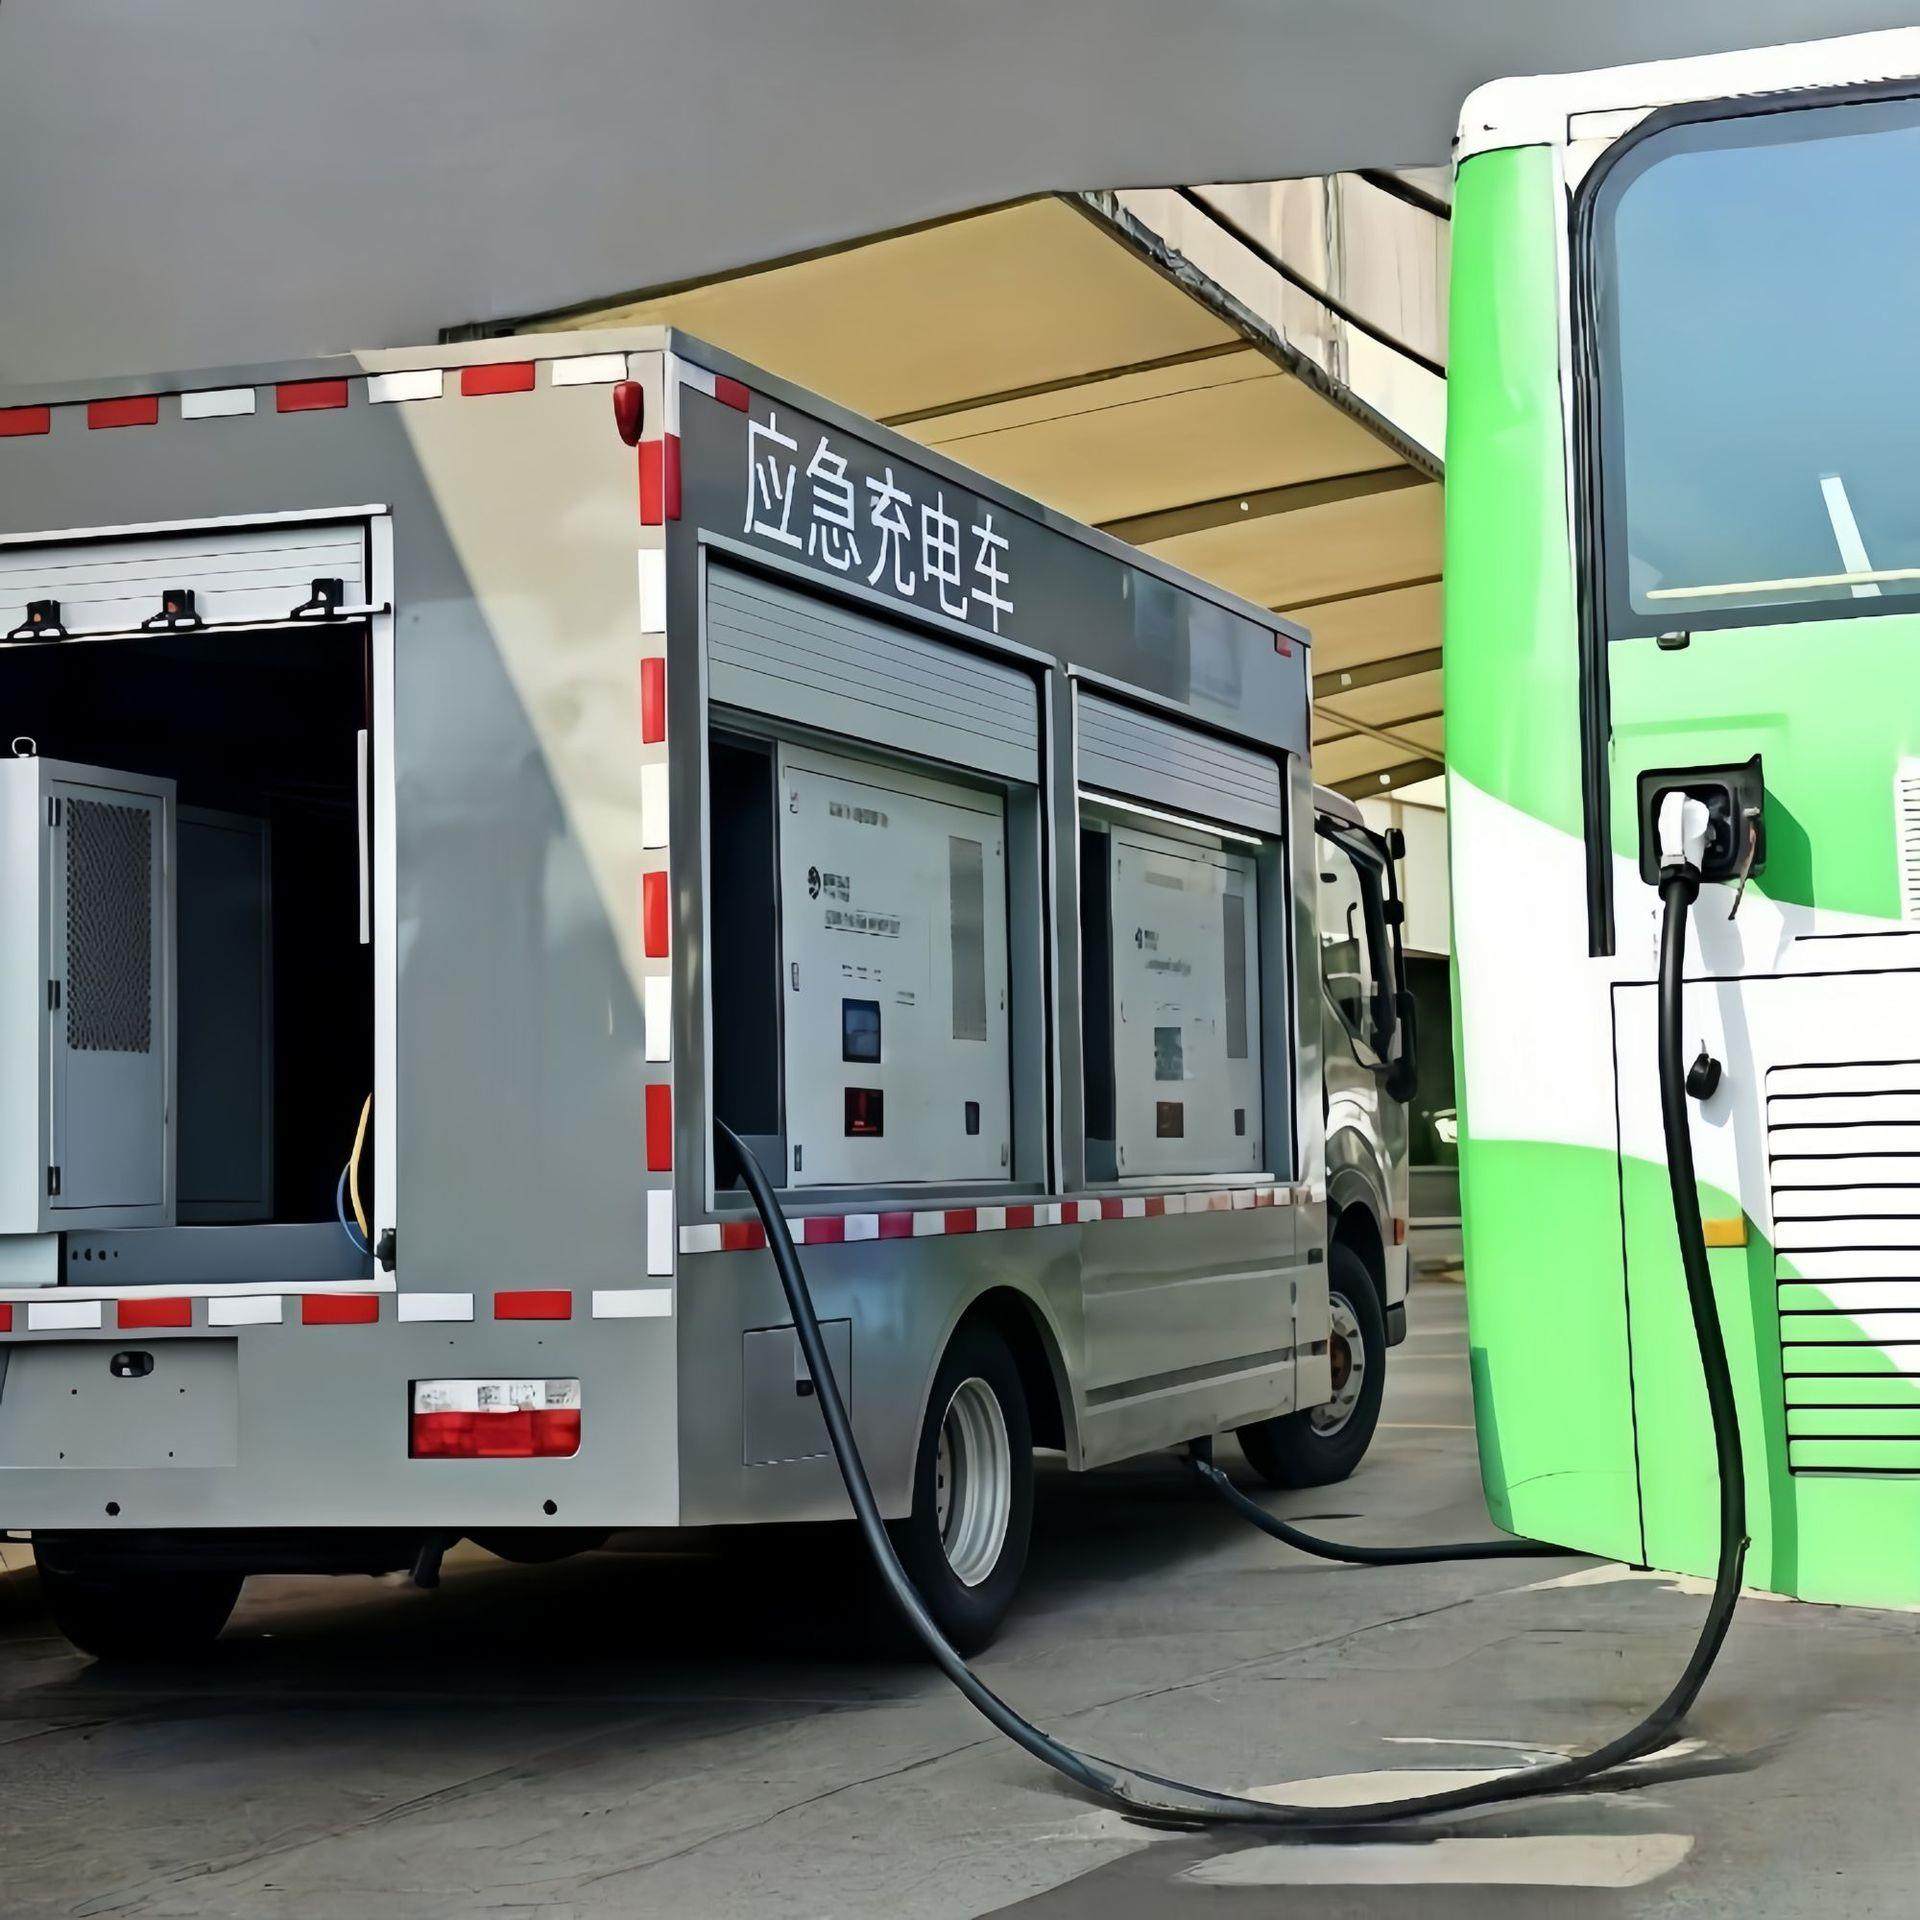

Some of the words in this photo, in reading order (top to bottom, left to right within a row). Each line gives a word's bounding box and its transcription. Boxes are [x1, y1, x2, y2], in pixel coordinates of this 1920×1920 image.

[744, 412, 1014, 633] 应急充电车
